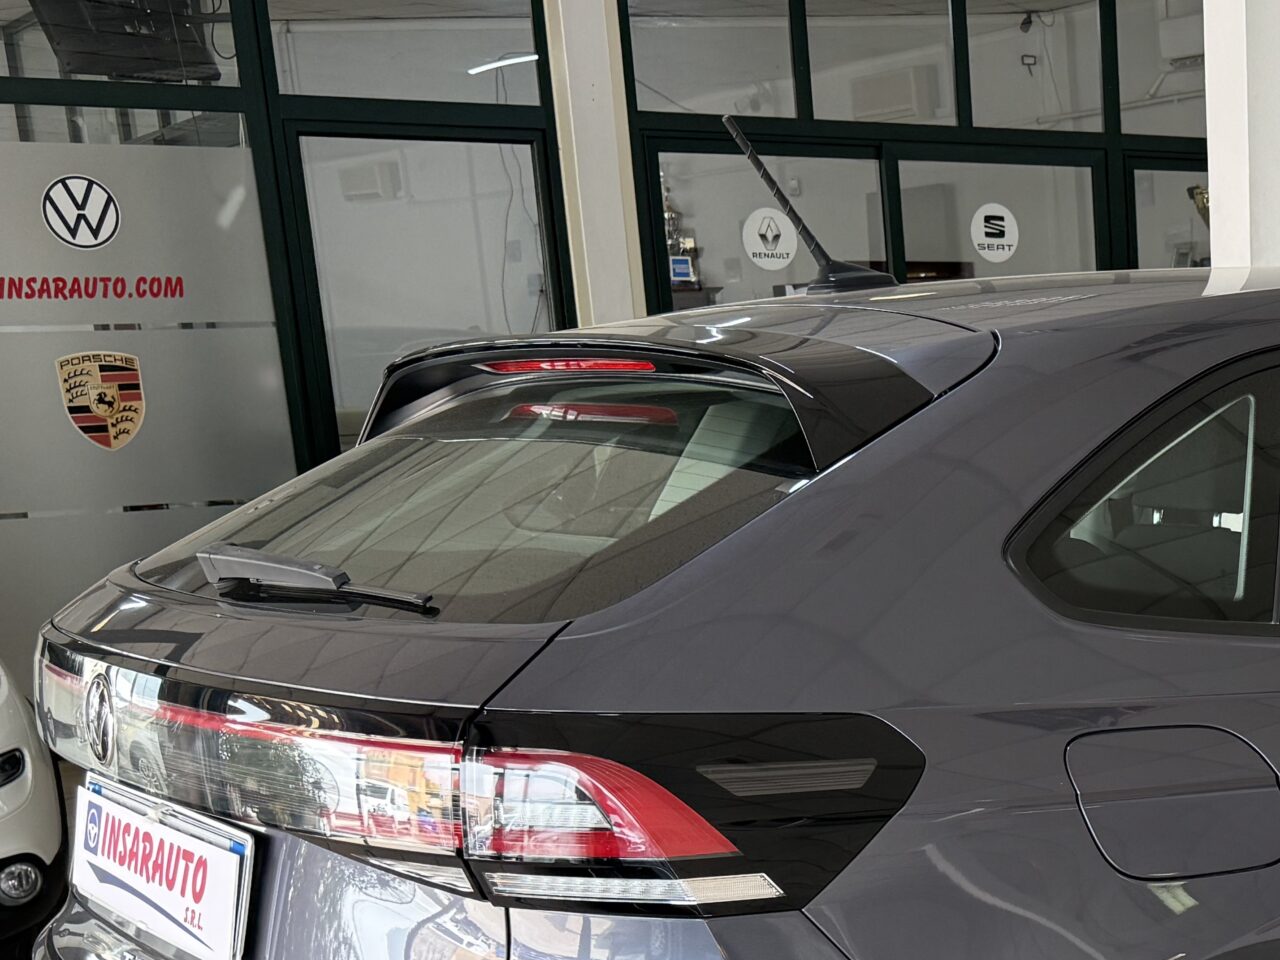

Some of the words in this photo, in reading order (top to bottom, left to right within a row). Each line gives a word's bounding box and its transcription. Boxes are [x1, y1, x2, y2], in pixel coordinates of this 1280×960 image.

[977, 243, 1014, 252] SEAT
[752, 251, 791, 260] RENAULT
[60, 353, 136, 370] PORSCHE
[100, 812, 209, 905] INSARAUTO
